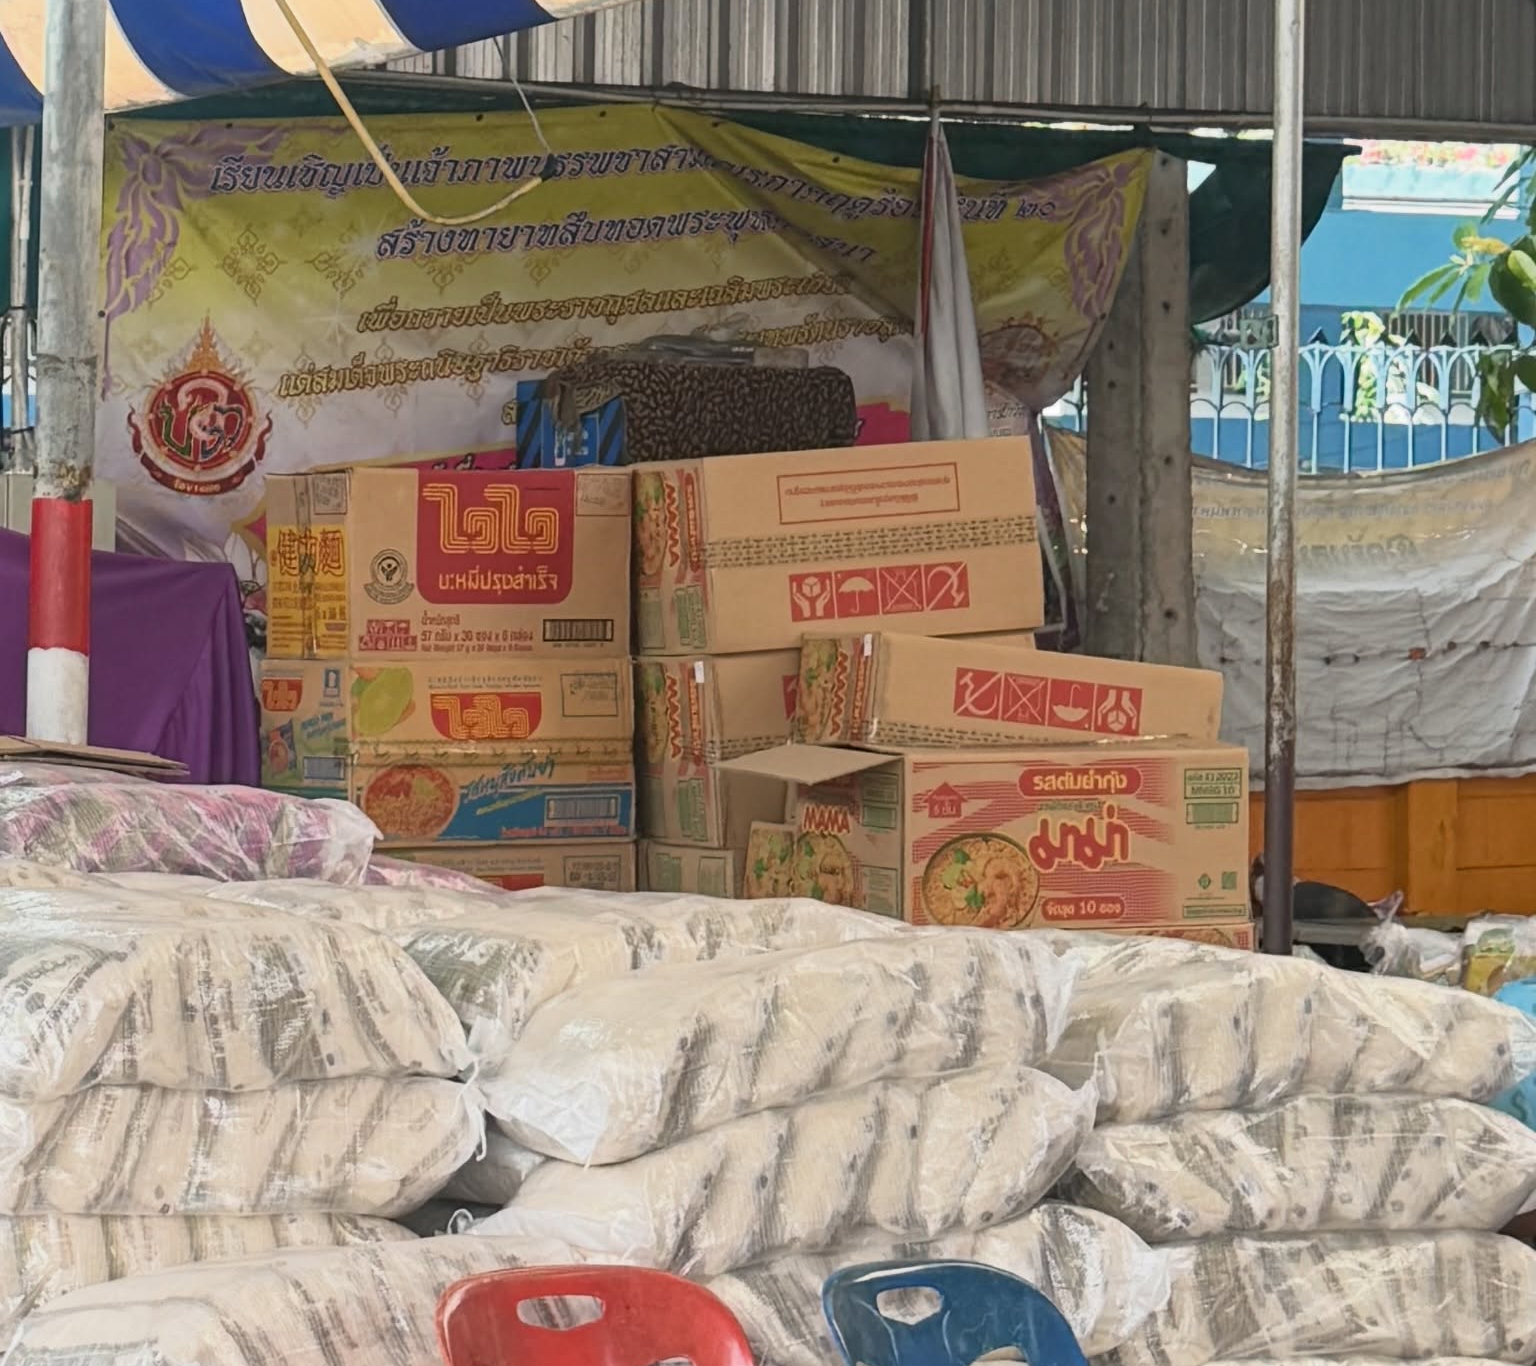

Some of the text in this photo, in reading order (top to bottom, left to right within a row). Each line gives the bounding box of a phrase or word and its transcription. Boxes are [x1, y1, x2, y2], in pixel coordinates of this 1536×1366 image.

[421, 482, 560, 555] ไวไว
[664, 481, 681, 568] MAMA
[438, 561, 559, 596] บะหมี่ปรุงสำเร็จ
[431, 693, 530, 740] ไวไว
[665, 673, 682, 762] MAMA
[1031, 769, 1128, 795] รสต้มยำกุ้ง
[802, 804, 852, 834] MAMA
[1027, 801, 1132, 874] มาม่า
[1079, 896, 1096, 913] 10
